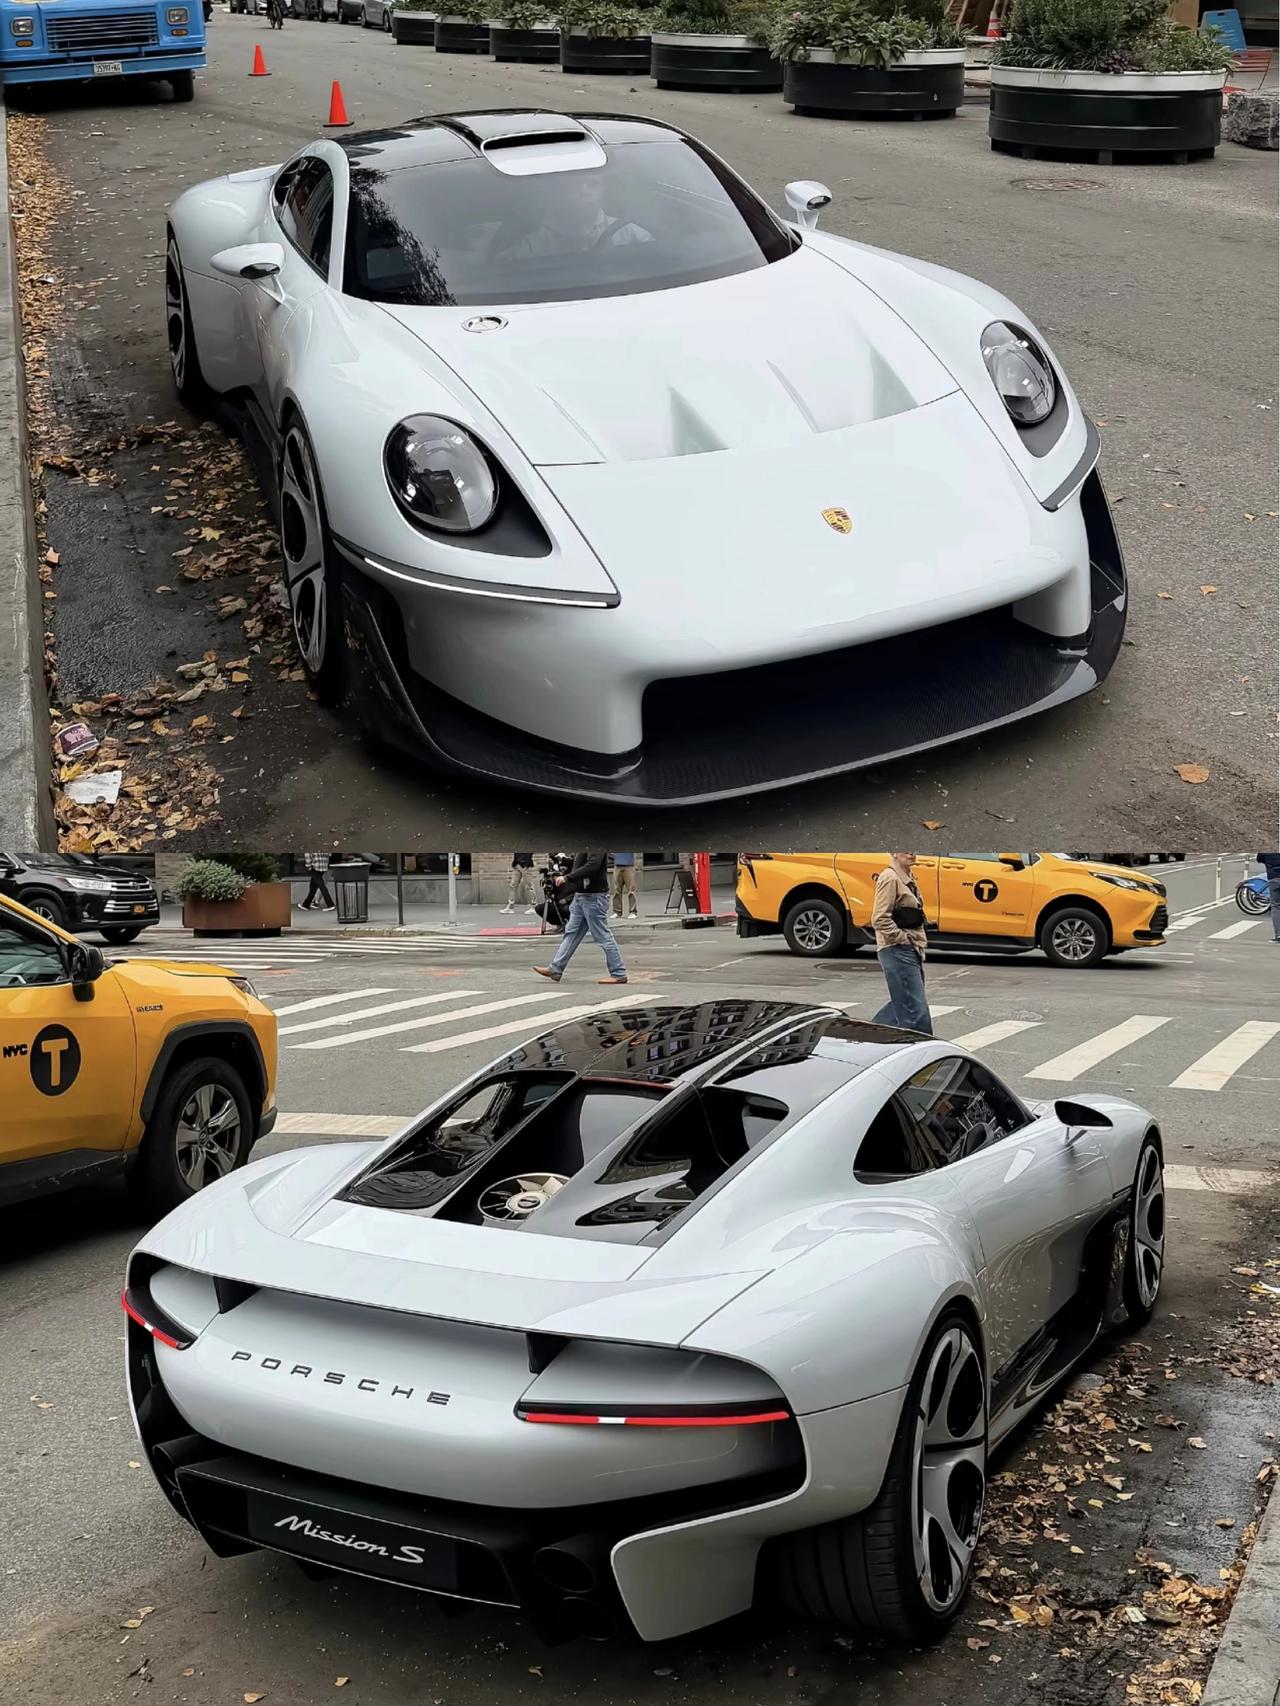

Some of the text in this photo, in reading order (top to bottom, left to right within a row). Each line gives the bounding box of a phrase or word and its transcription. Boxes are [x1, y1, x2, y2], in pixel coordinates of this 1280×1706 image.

[979, 883, 994, 900] T
[2, 1037, 70, 1087] NYC T
[231, 1350, 451, 1406] PORSCHE
[274, 1515, 426, 1564] Mission S
